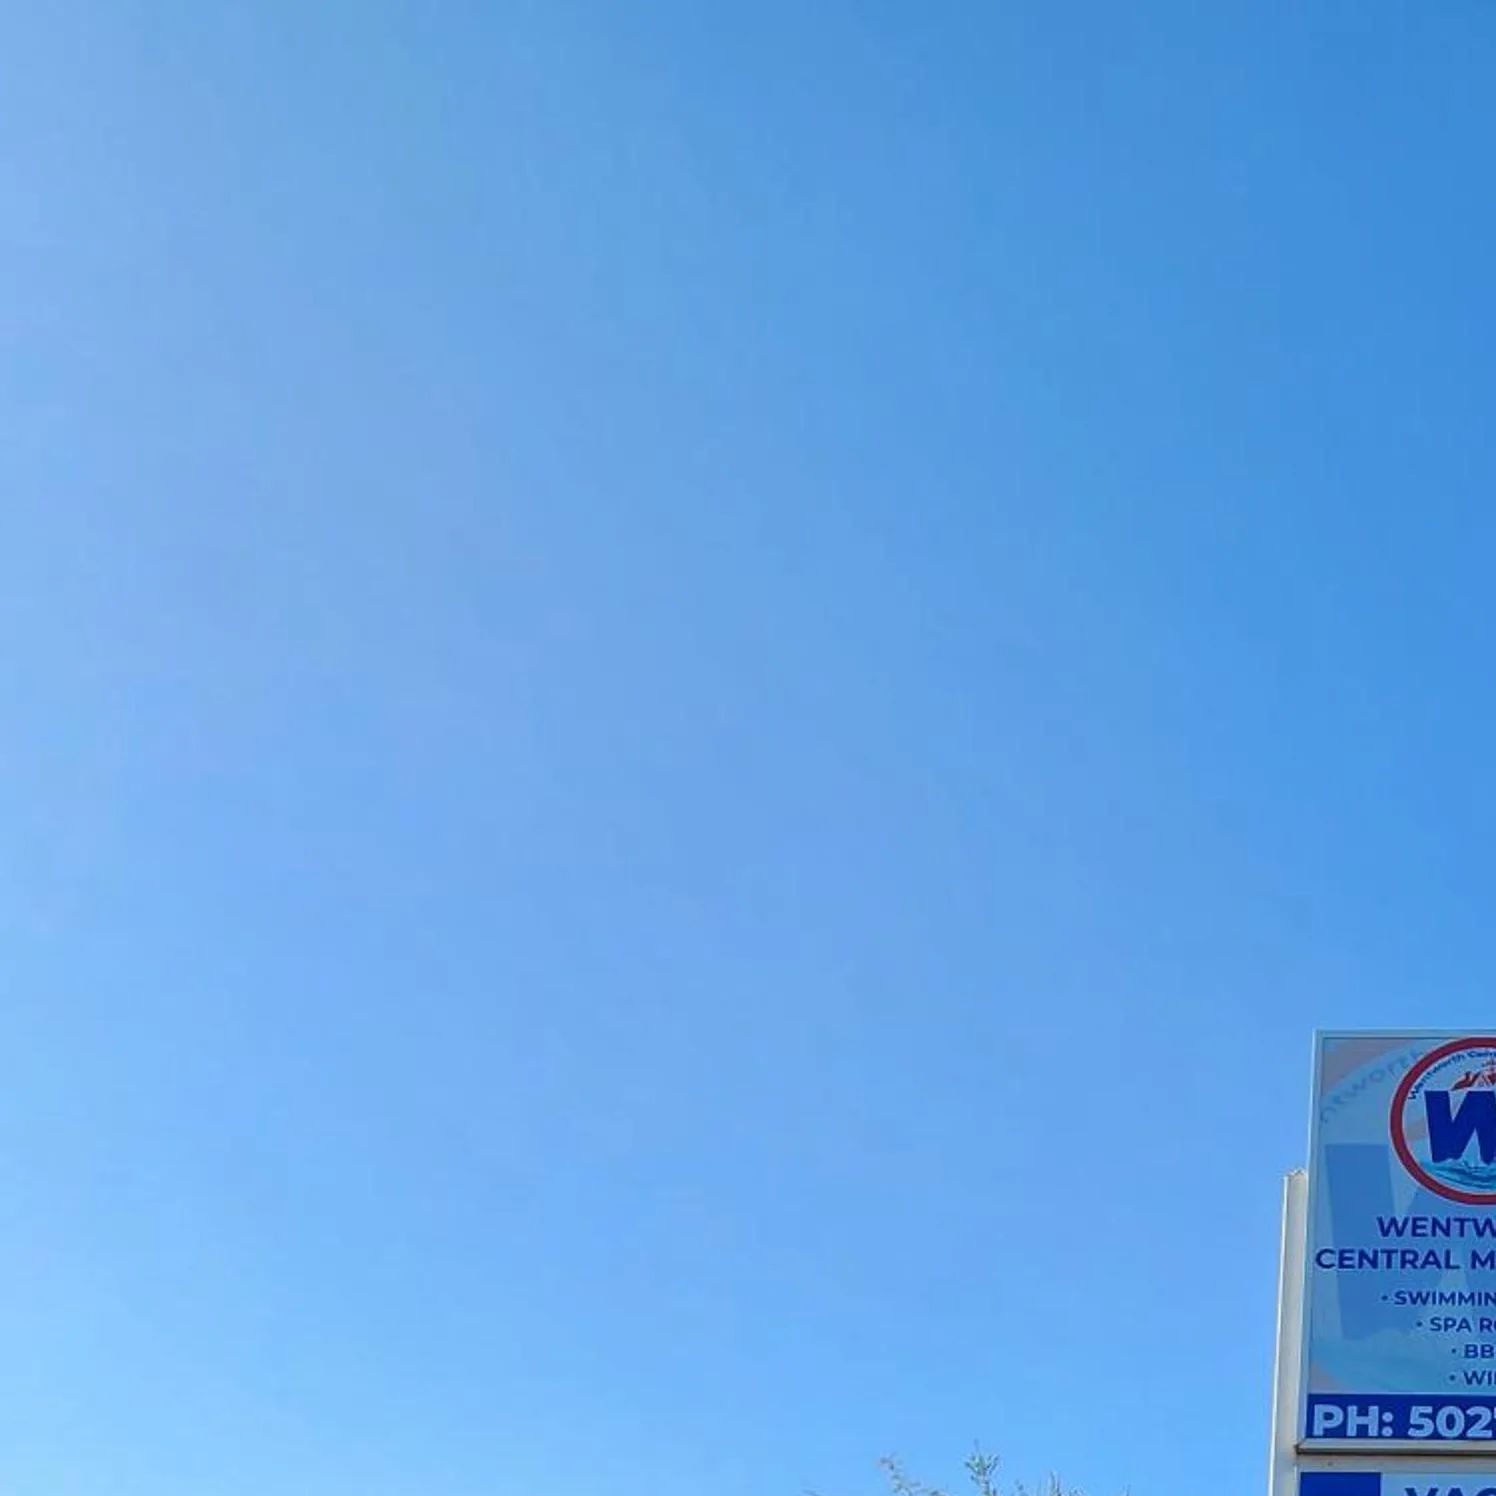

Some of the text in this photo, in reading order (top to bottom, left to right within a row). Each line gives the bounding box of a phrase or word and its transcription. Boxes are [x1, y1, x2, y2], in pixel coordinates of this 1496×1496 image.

[1315, 1248, 1460, 1270] CENTRAL
[1429, 1317, 1472, 1333] SPA
[1312, 1403, 1394, 1437] PH:
